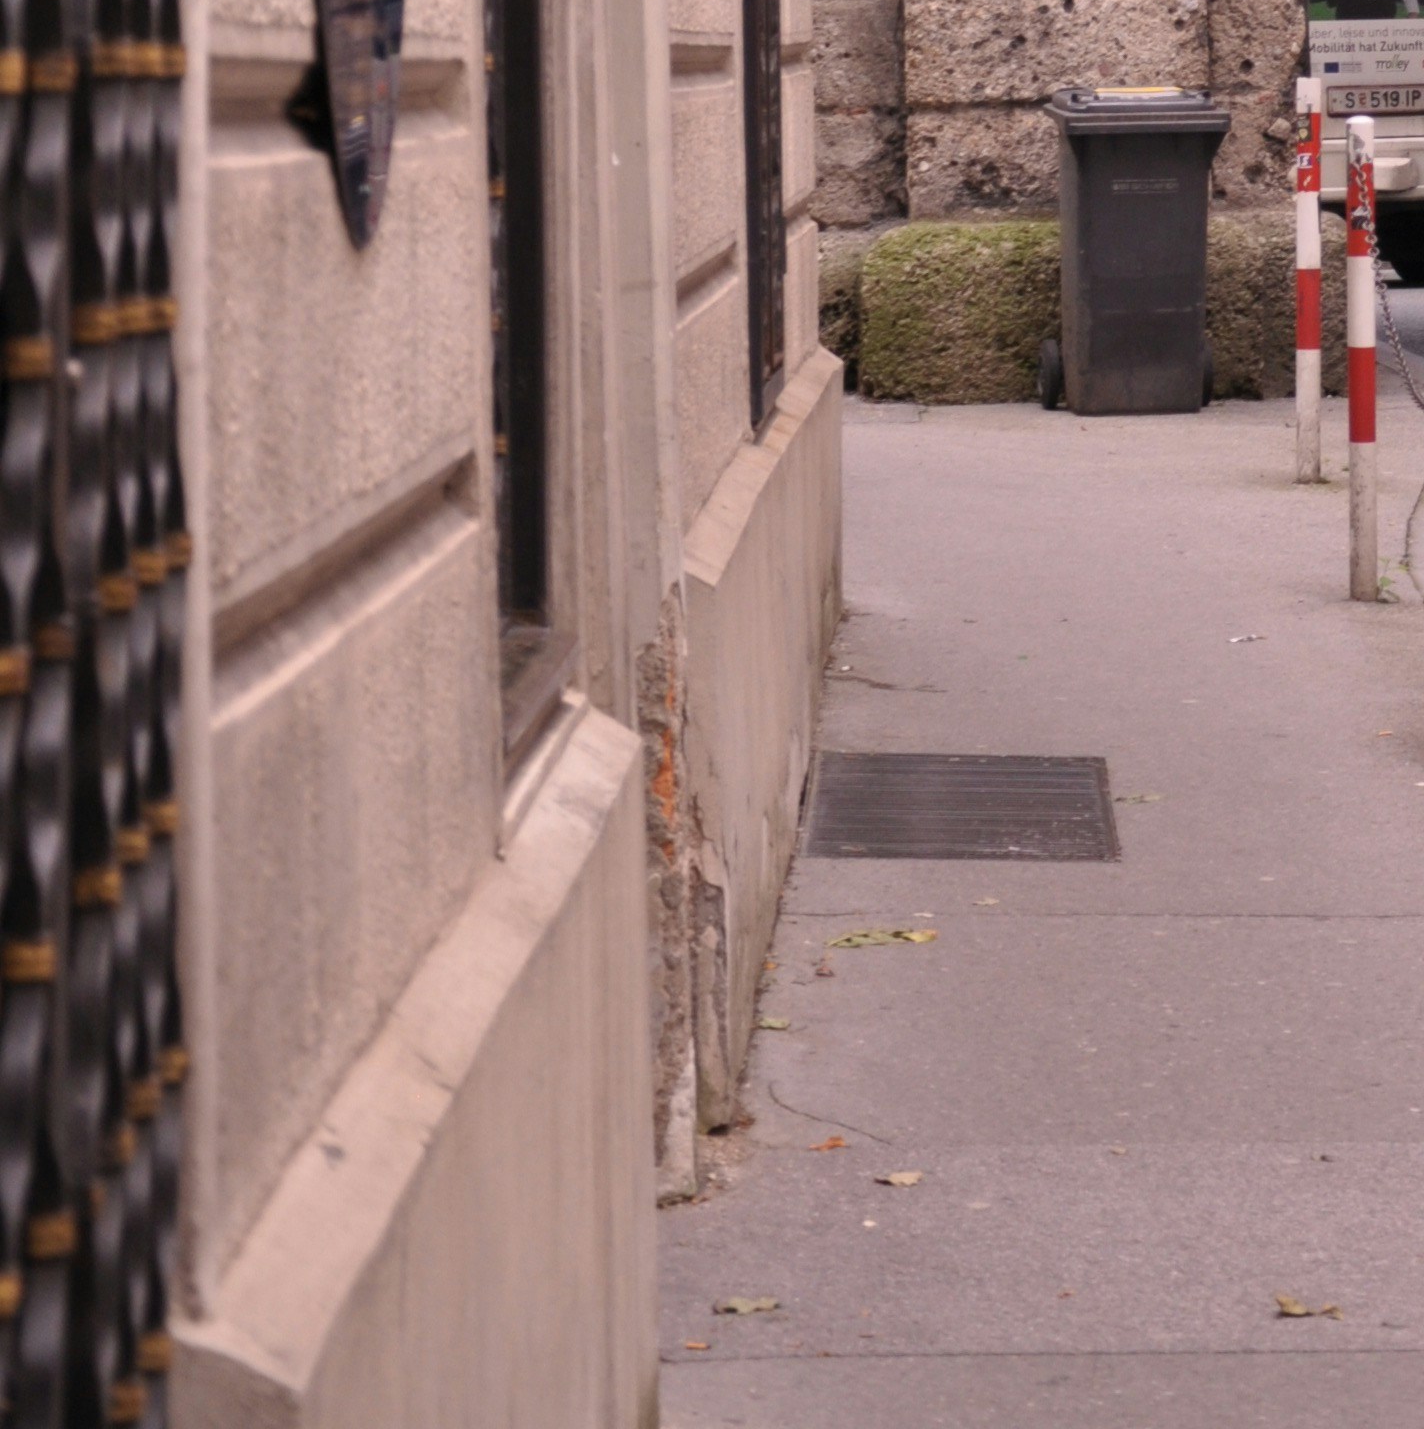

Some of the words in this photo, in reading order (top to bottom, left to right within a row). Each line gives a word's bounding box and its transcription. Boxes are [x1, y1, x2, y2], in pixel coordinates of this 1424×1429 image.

[1368, 27, 1389, 38] und
[1360, 41, 1376, 52] hat
[1345, 92, 1356, 109] S
